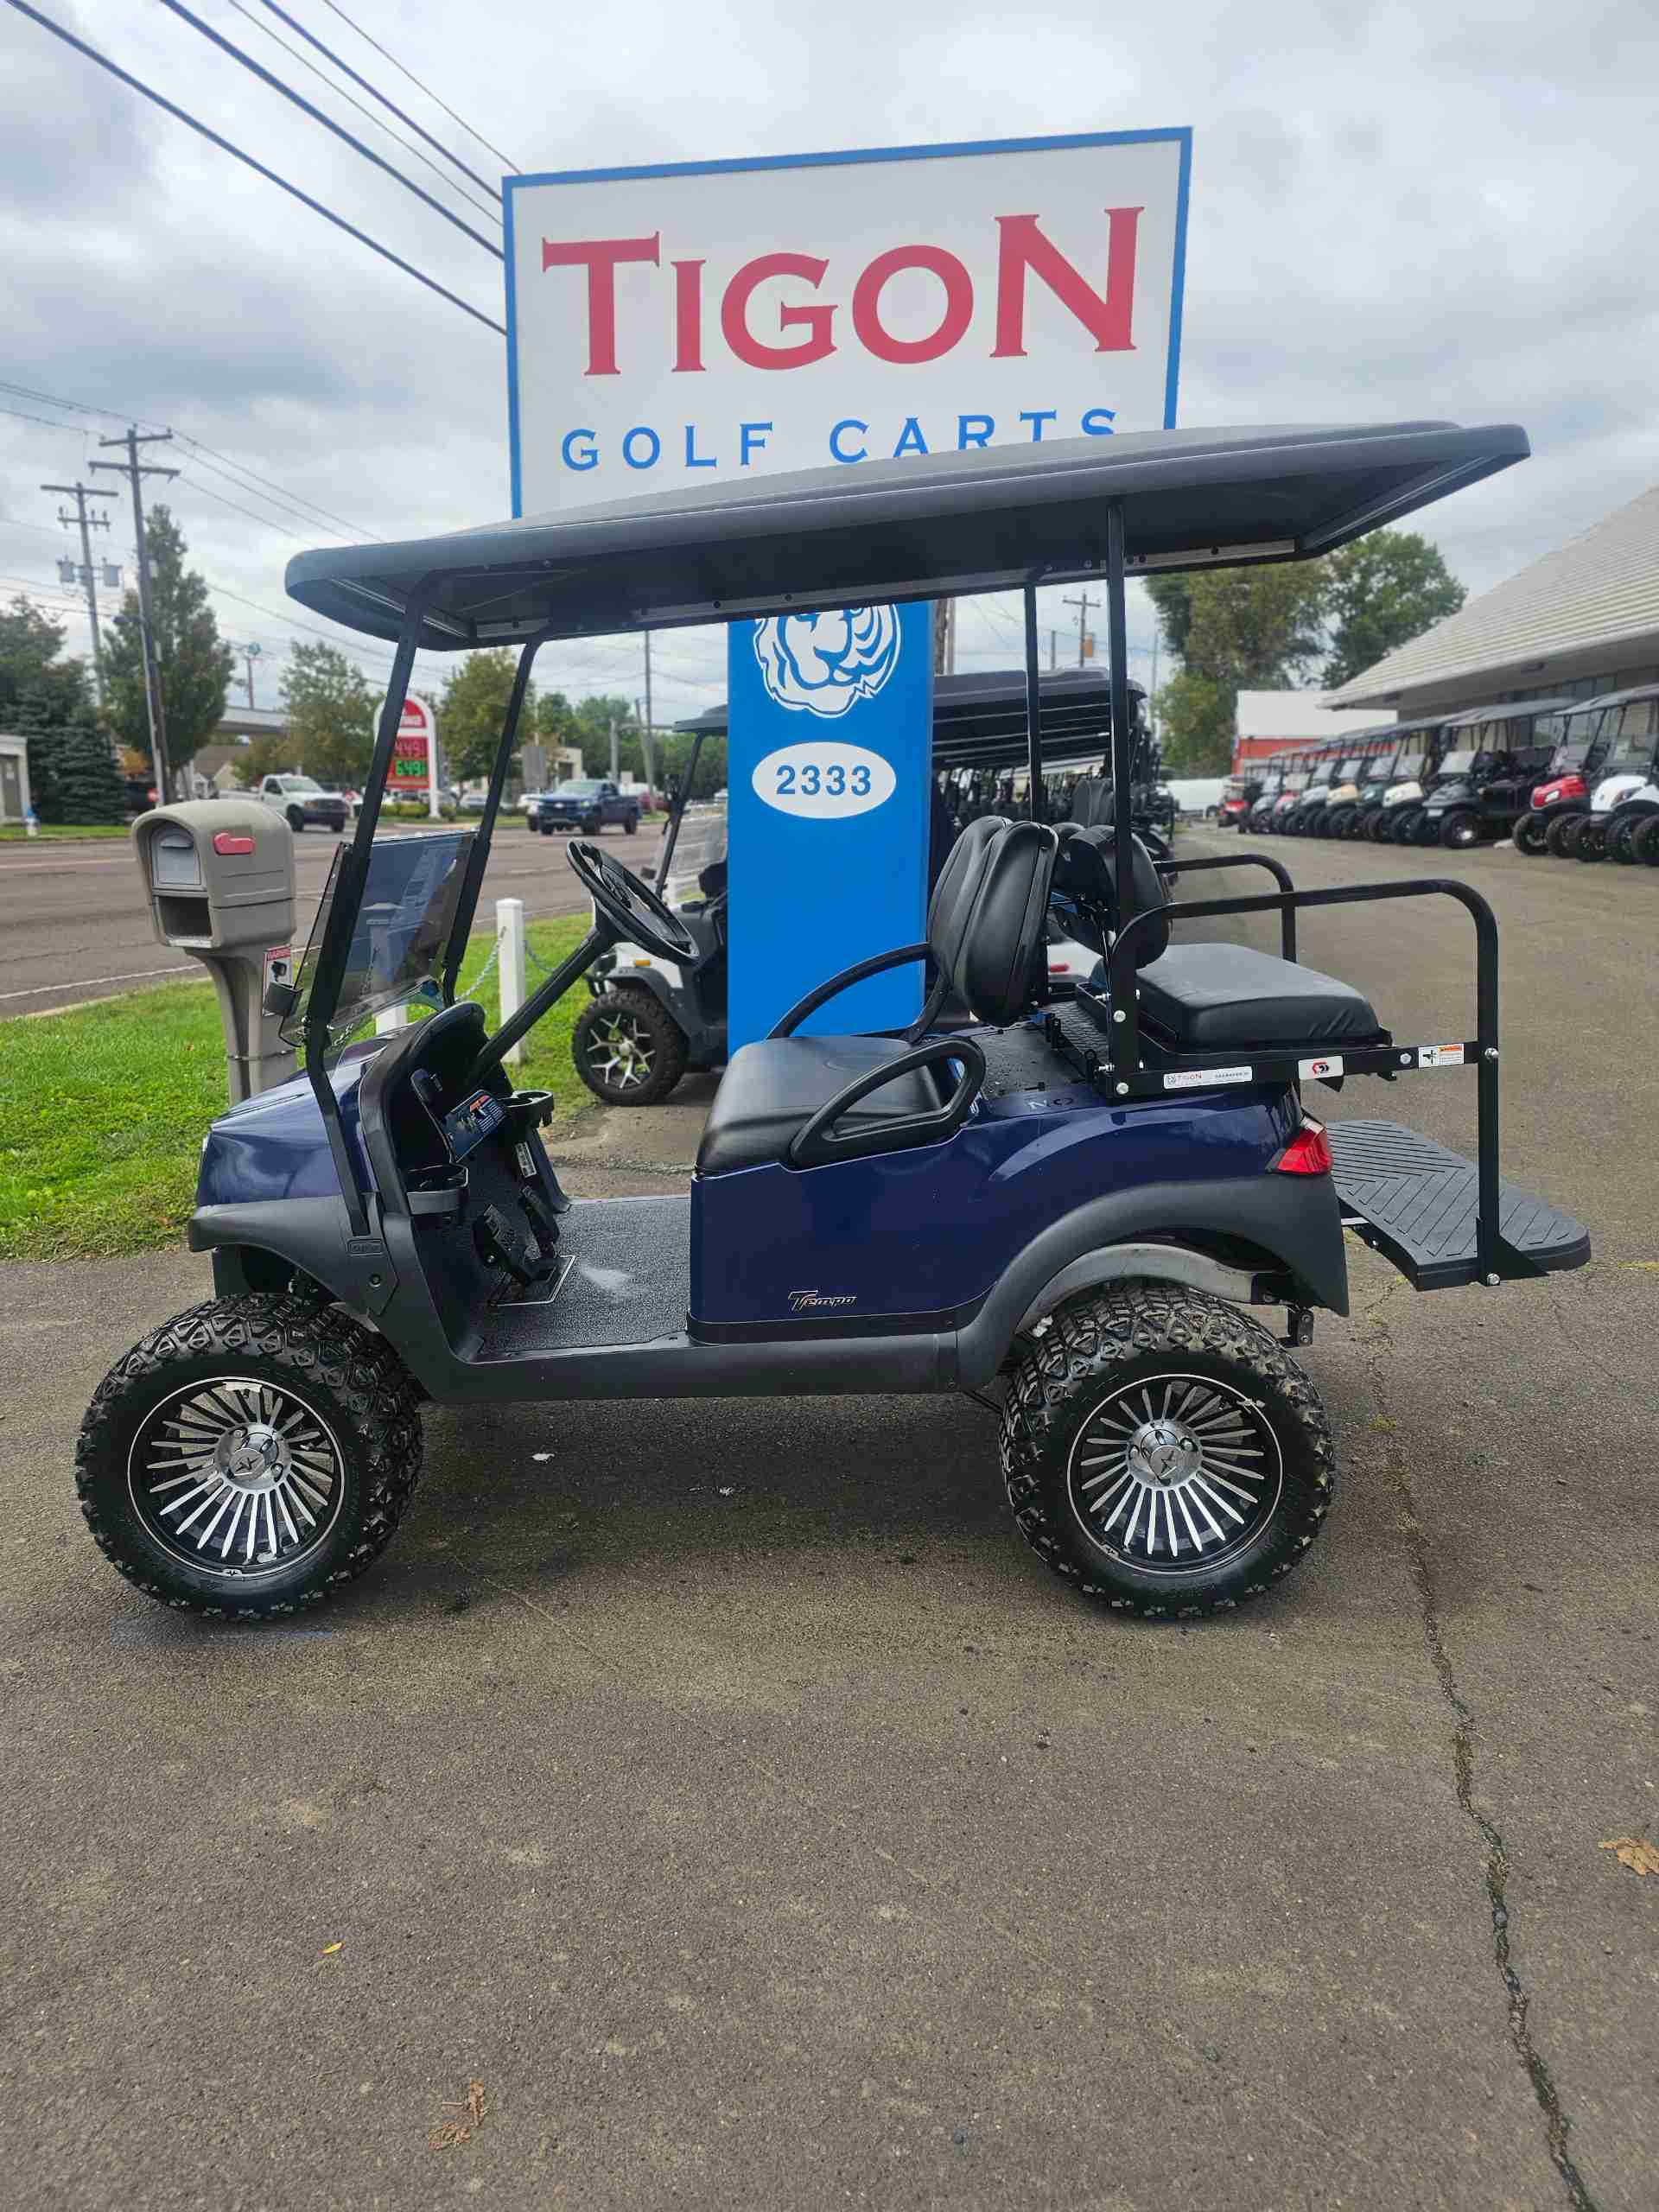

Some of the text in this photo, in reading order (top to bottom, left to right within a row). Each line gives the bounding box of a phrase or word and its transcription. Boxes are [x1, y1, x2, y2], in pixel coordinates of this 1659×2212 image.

[542, 206, 1145, 376] TIGON
[562, 408, 1116, 472] GOLF CARTS
[776, 765, 871, 796] 2333
[788, 1082, 858, 1290] Tempo
